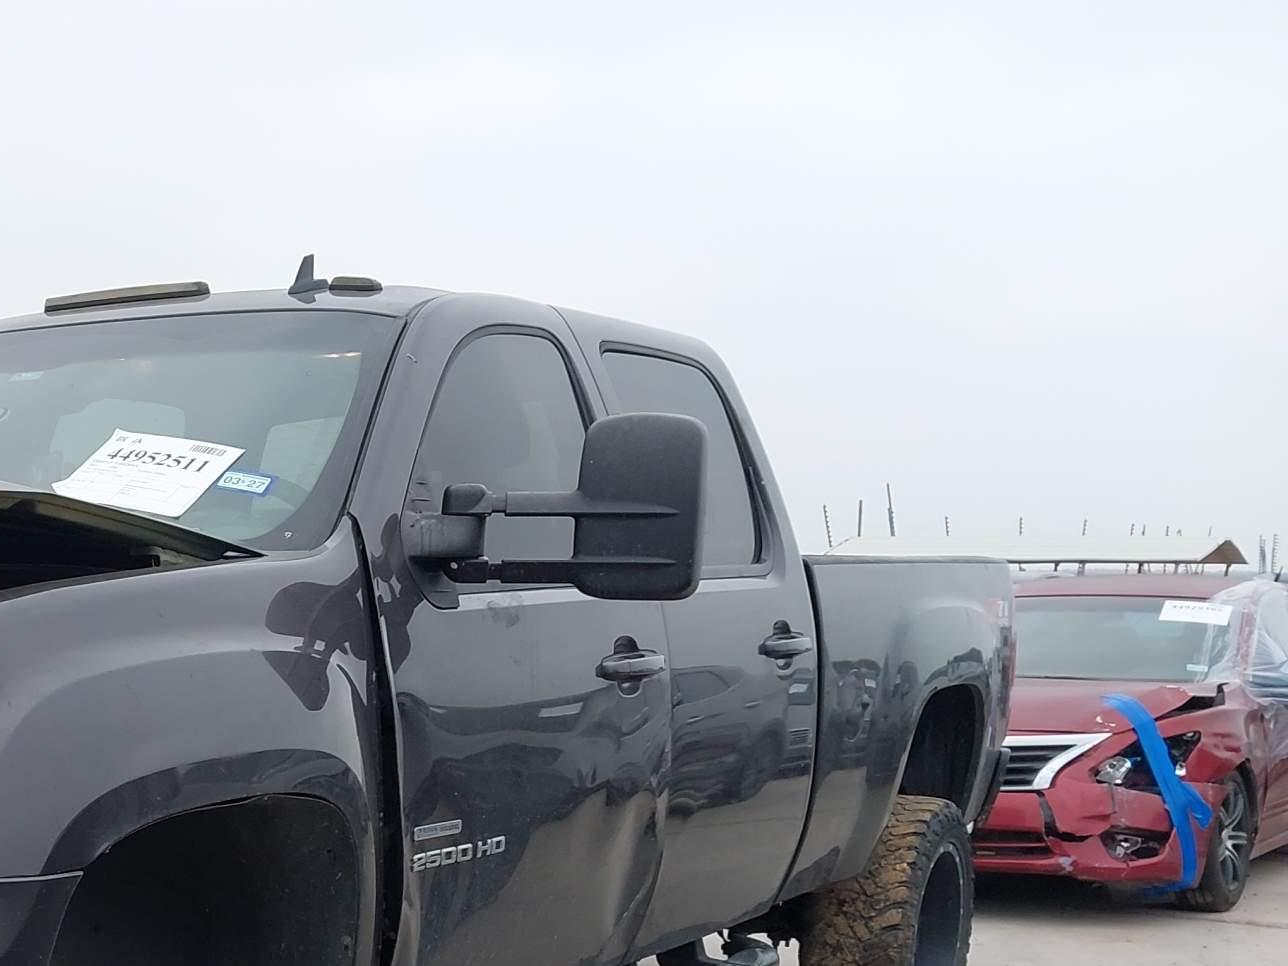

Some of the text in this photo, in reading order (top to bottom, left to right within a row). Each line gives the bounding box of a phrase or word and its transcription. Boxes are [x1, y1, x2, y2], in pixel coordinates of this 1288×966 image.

[106, 447, 211, 473] 44952511
[412, 835, 506, 872] 2500 HD
